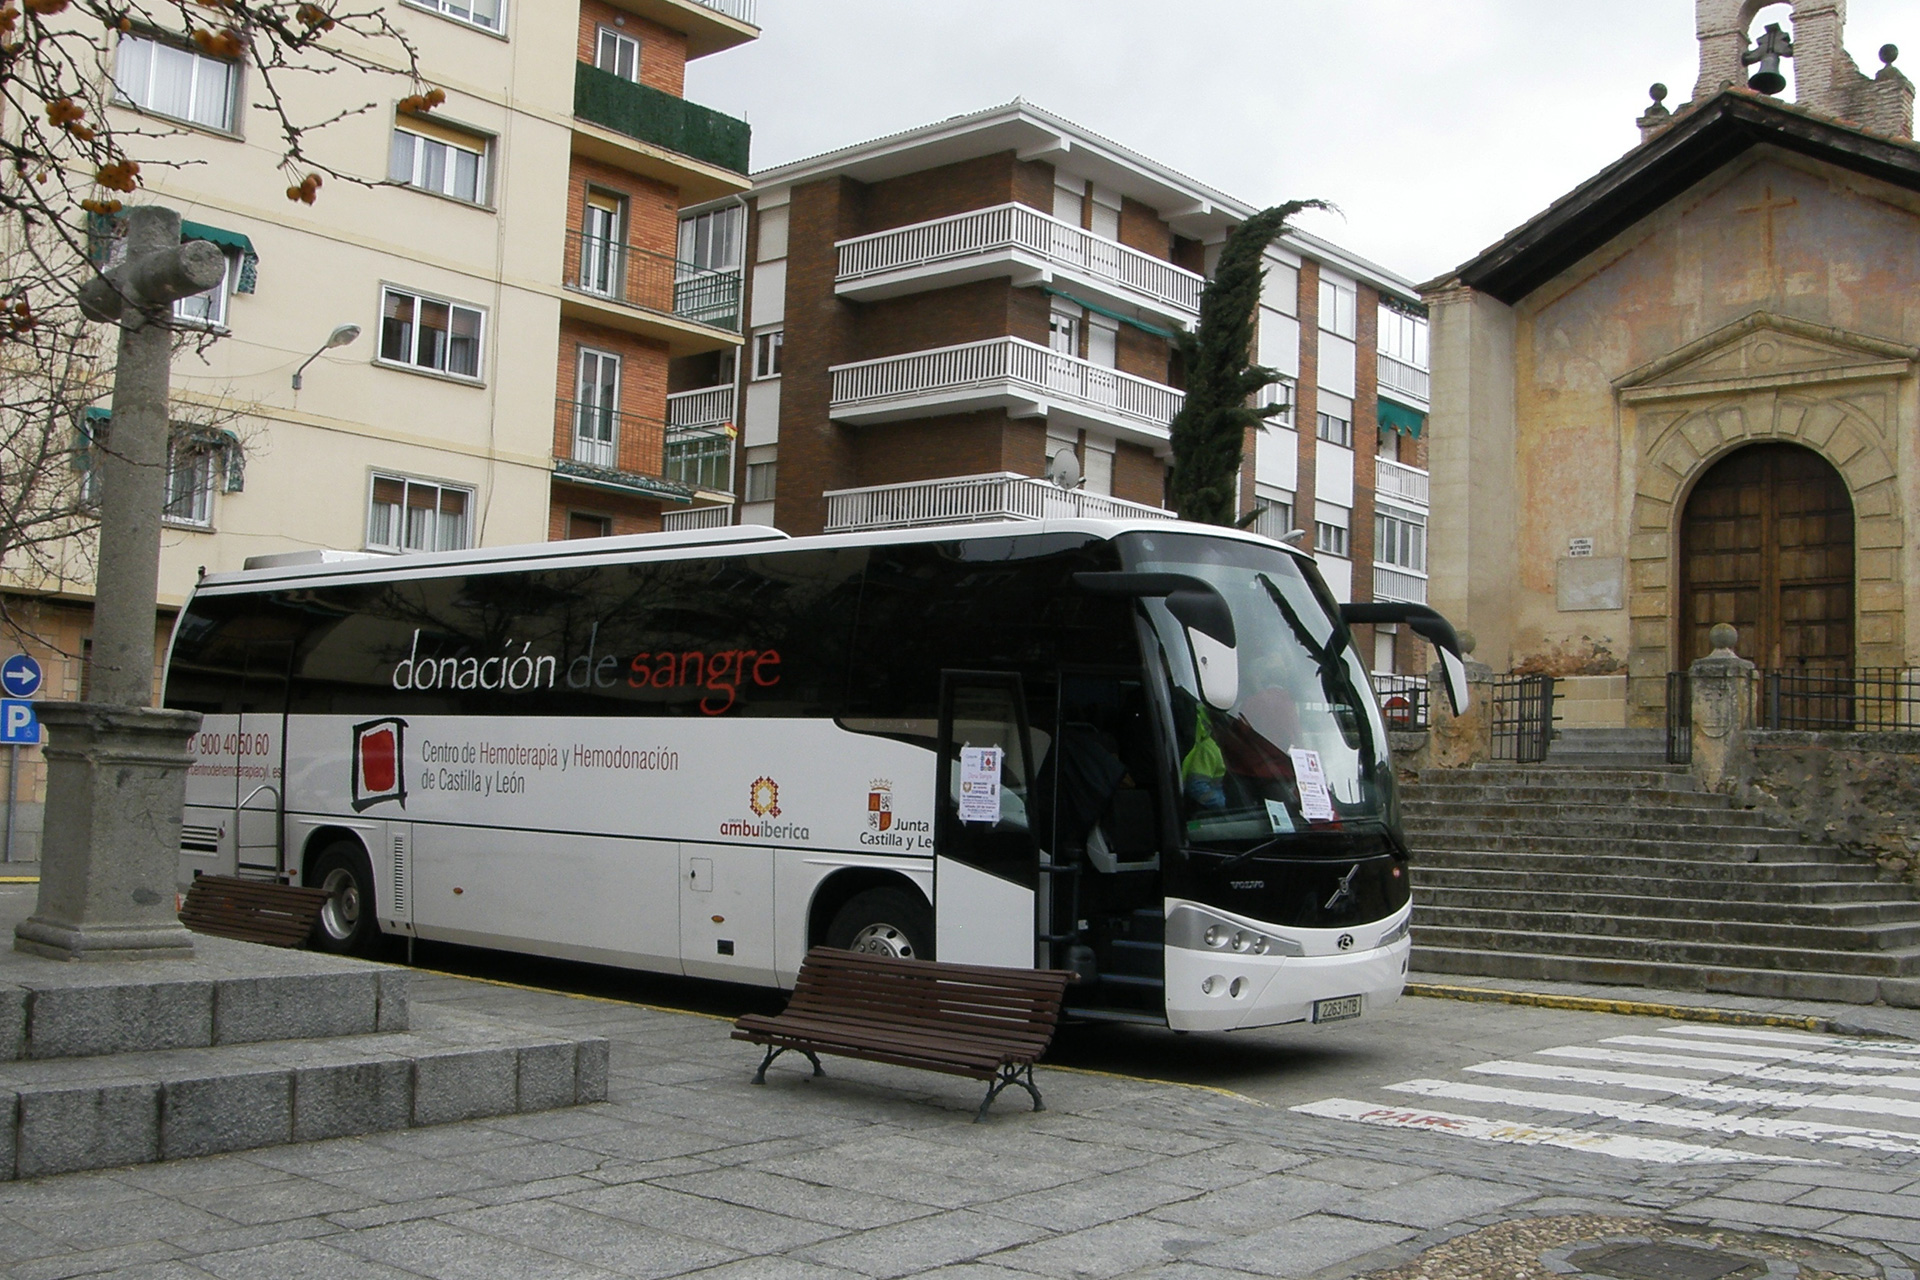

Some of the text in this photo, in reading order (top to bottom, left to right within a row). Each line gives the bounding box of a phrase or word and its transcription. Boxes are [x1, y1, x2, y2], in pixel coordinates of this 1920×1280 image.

[392, 621, 781, 716] donación de sangre
[7, 704, 31, 737] P
[201, 733, 269, 755] 900 40 50 60
[422, 740, 679, 772] Centro de Hemoterapia y Hemodonación
[421, 768, 525, 797] de Castilla y León
[720, 819, 809, 840] ambuiberica
[895, 818, 929, 832] Junta
[860, 831, 935, 851] Castilla y Le
[1230, 881, 1264, 889] VOLVO
[1322, 998, 1358, 1017] 2263 HTB
